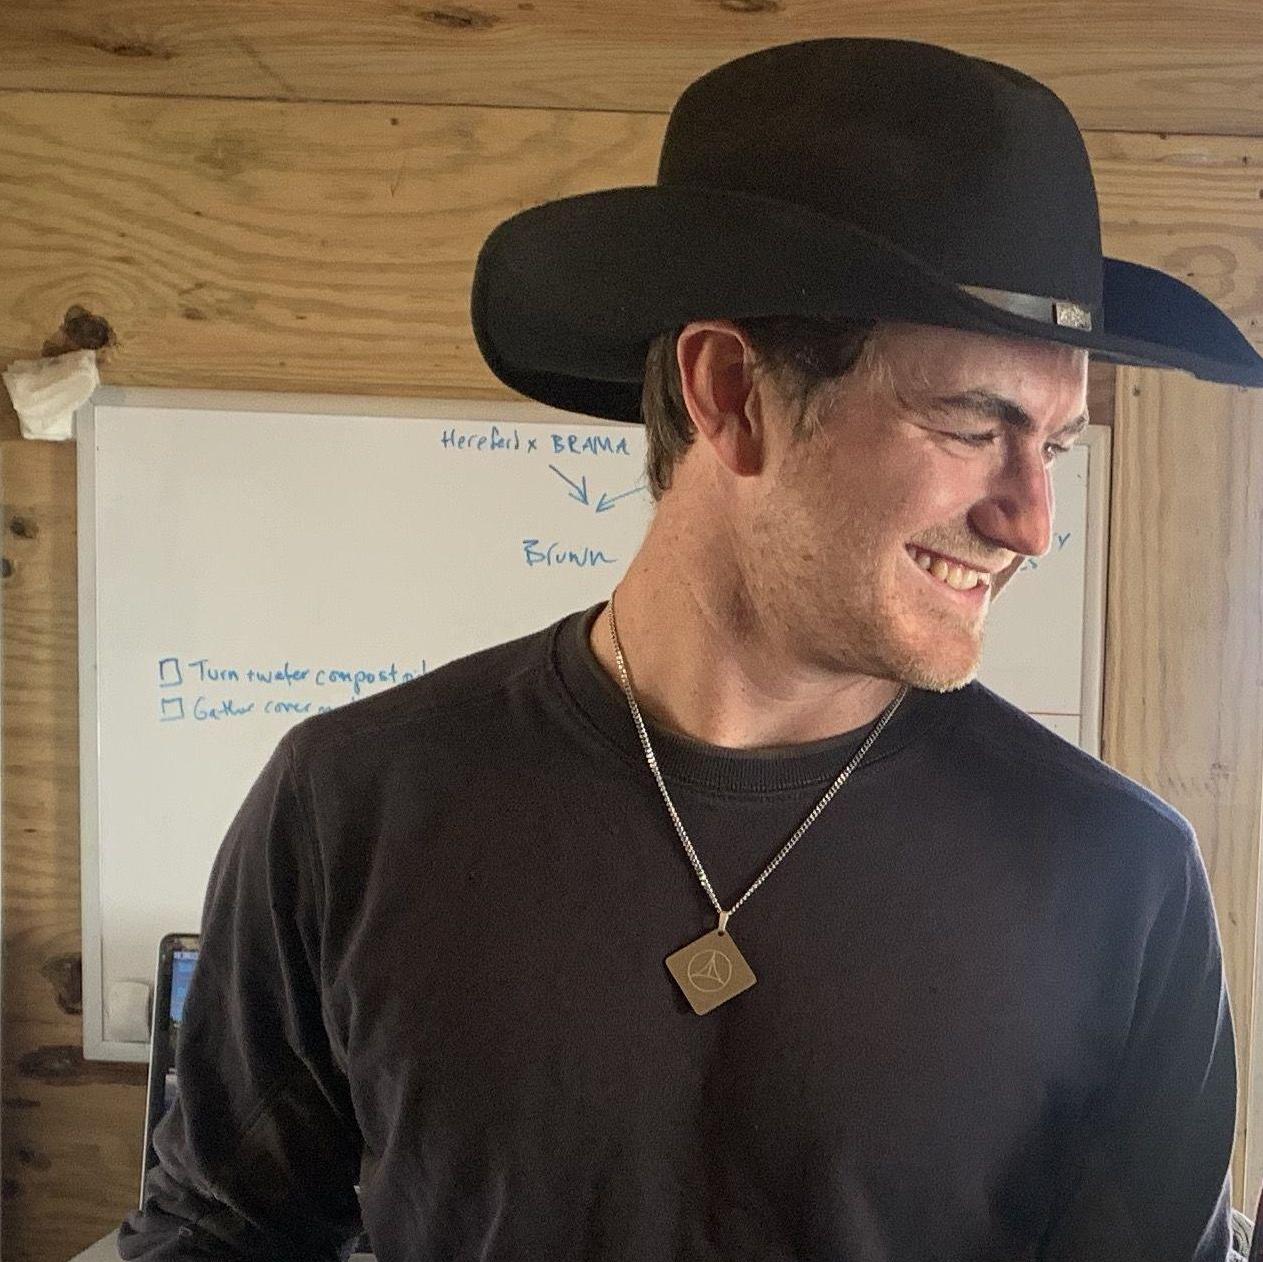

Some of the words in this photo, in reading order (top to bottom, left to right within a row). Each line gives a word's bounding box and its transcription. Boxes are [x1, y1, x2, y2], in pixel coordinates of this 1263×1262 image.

[551, 433, 630, 456] BRAMA
[188, 659, 239, 681] Turn
[316, 663, 398, 693] compost
[193, 697, 255, 720] Gather
